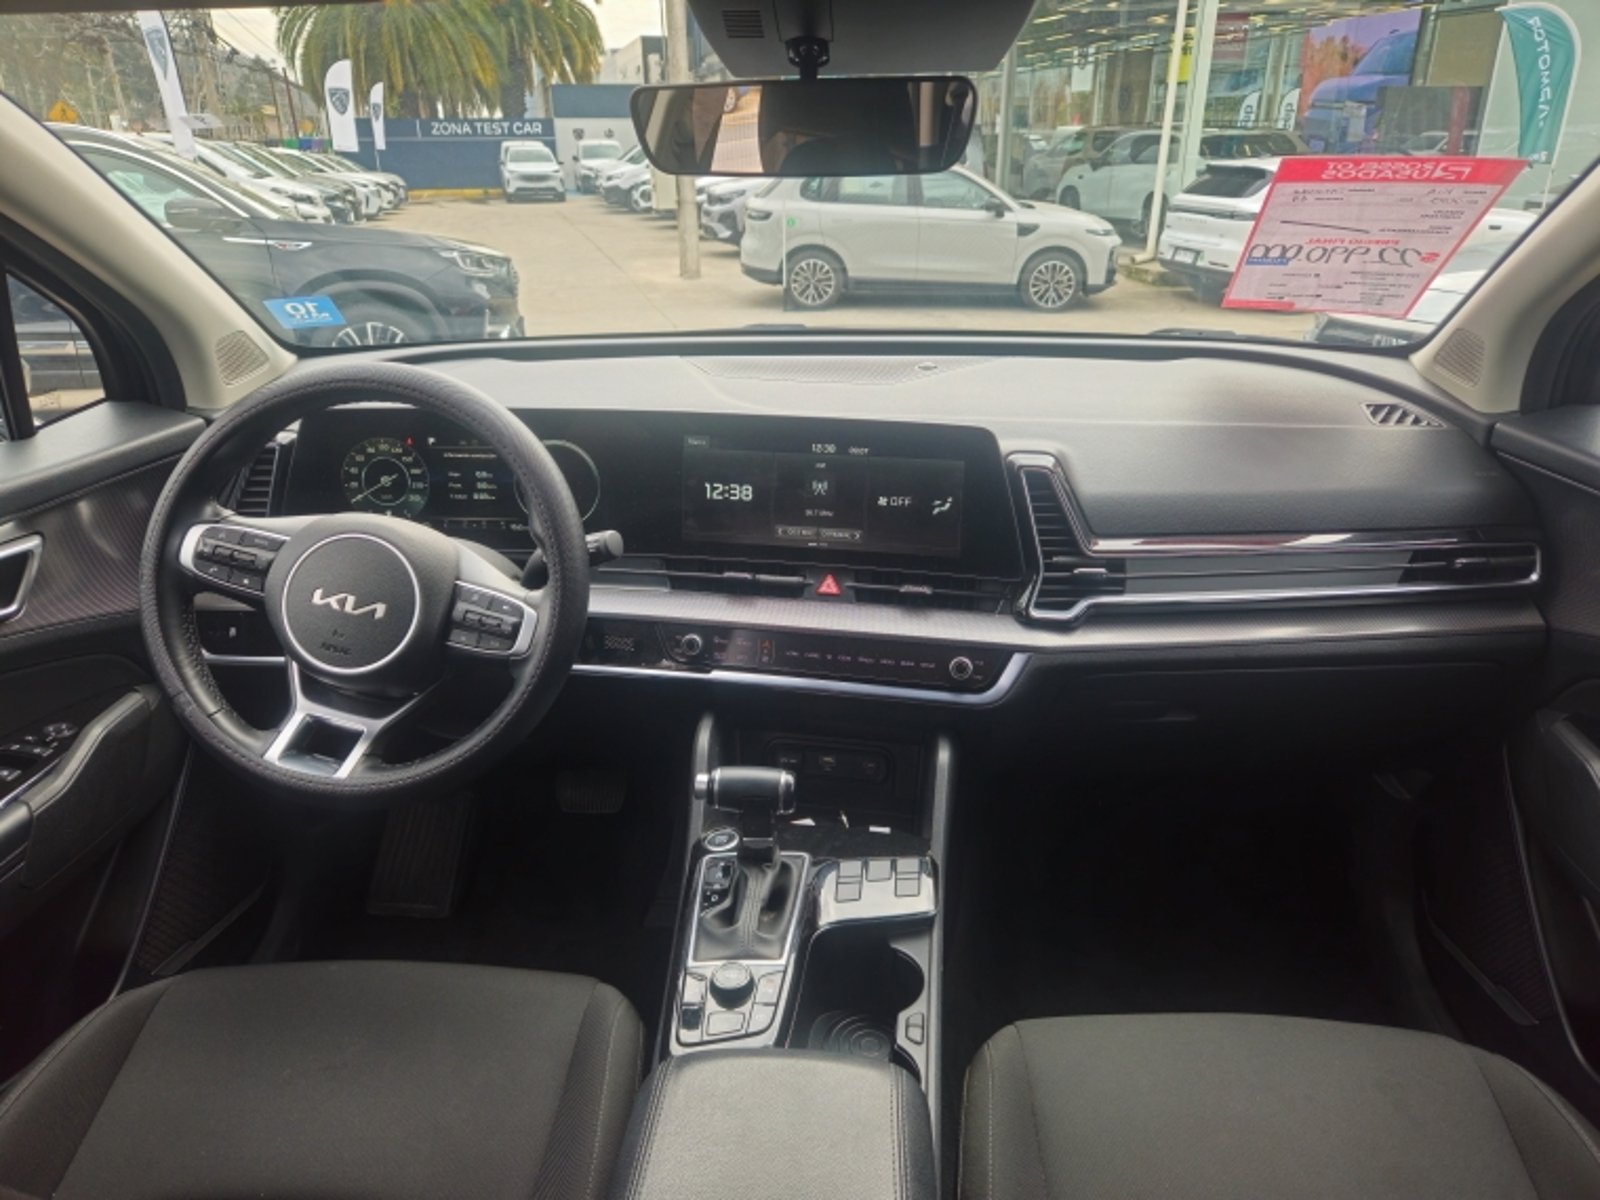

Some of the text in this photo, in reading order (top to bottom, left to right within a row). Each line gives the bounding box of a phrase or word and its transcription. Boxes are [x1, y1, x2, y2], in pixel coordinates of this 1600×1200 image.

[431, 122, 542, 135] ZONA TEST CAR
[704, 482, 753, 501] 12:38
[890, 496, 912, 507] OFF
[311, 587, 387, 620] KIA
